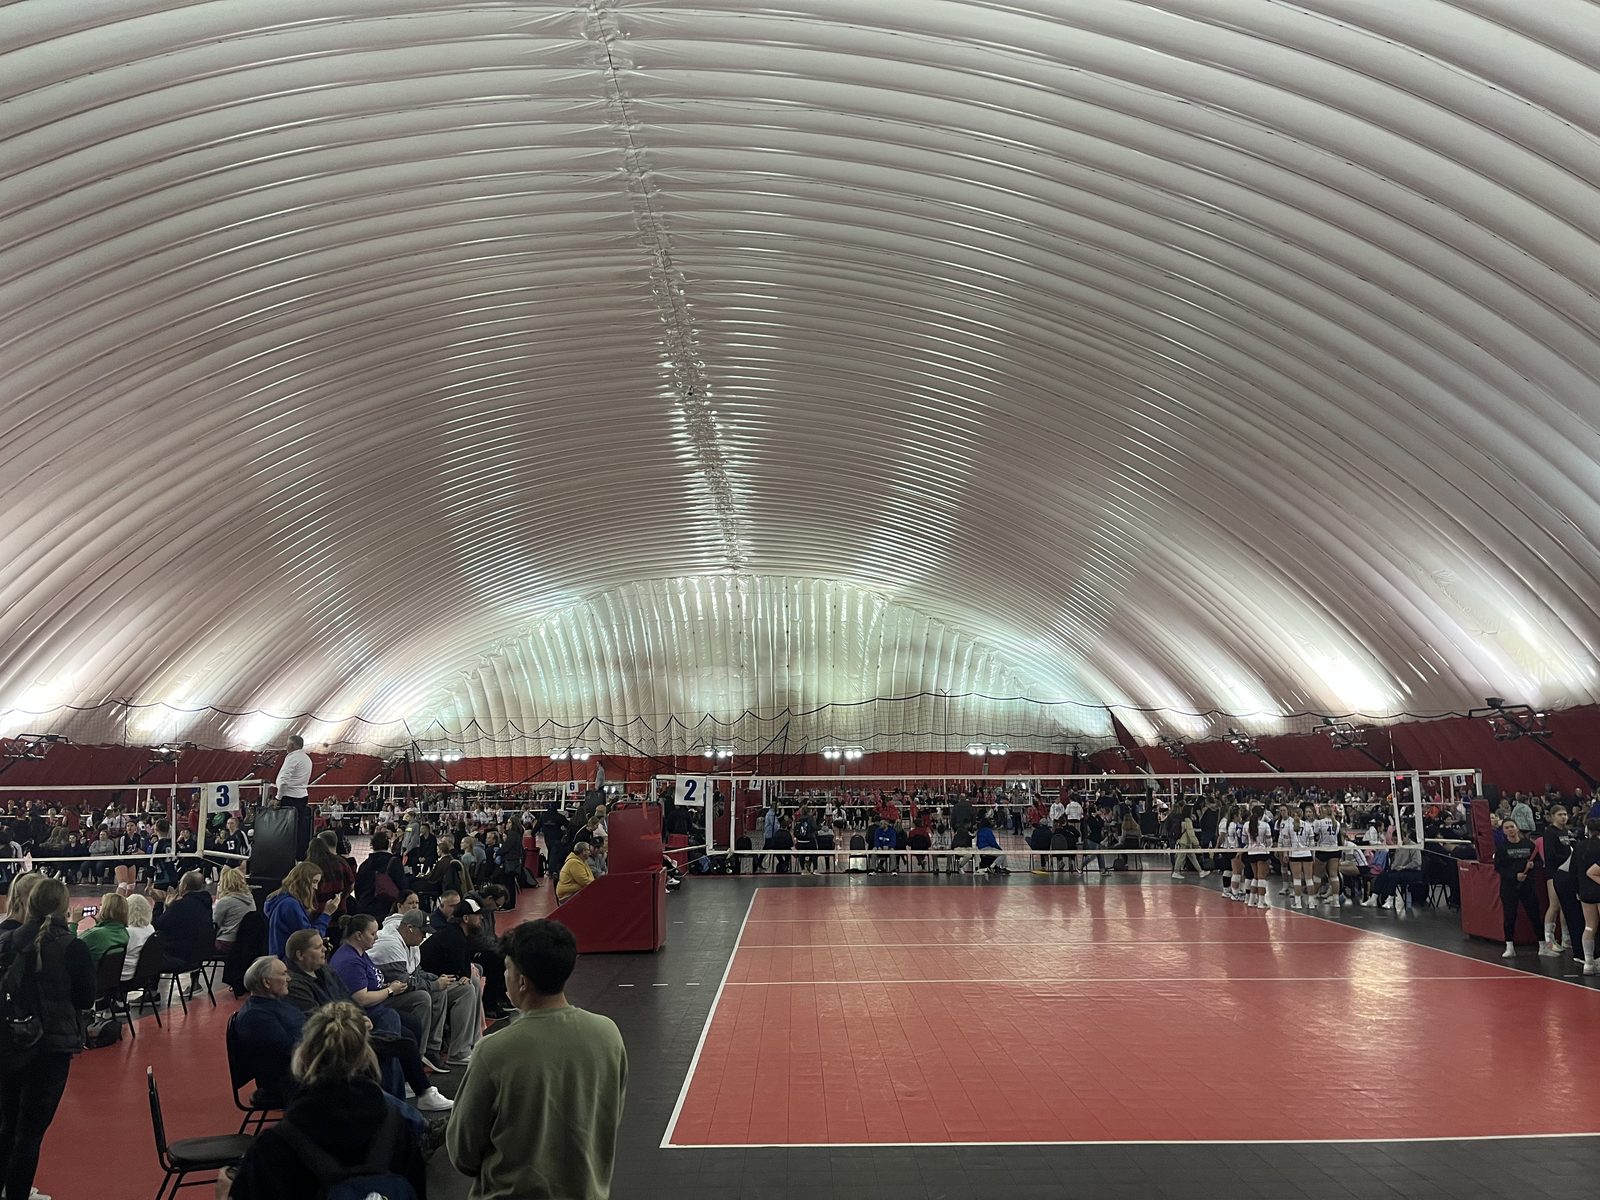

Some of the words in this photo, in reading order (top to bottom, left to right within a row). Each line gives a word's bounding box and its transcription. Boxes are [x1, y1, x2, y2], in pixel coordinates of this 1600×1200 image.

[1456, 775, 1462, 785] 8
[569, 782, 575, 791] 6
[684, 780, 697, 801] 2
[216, 785, 230, 807] 3
[1535, 812, 1541, 820] 5
[226, 840, 235, 850] 13
